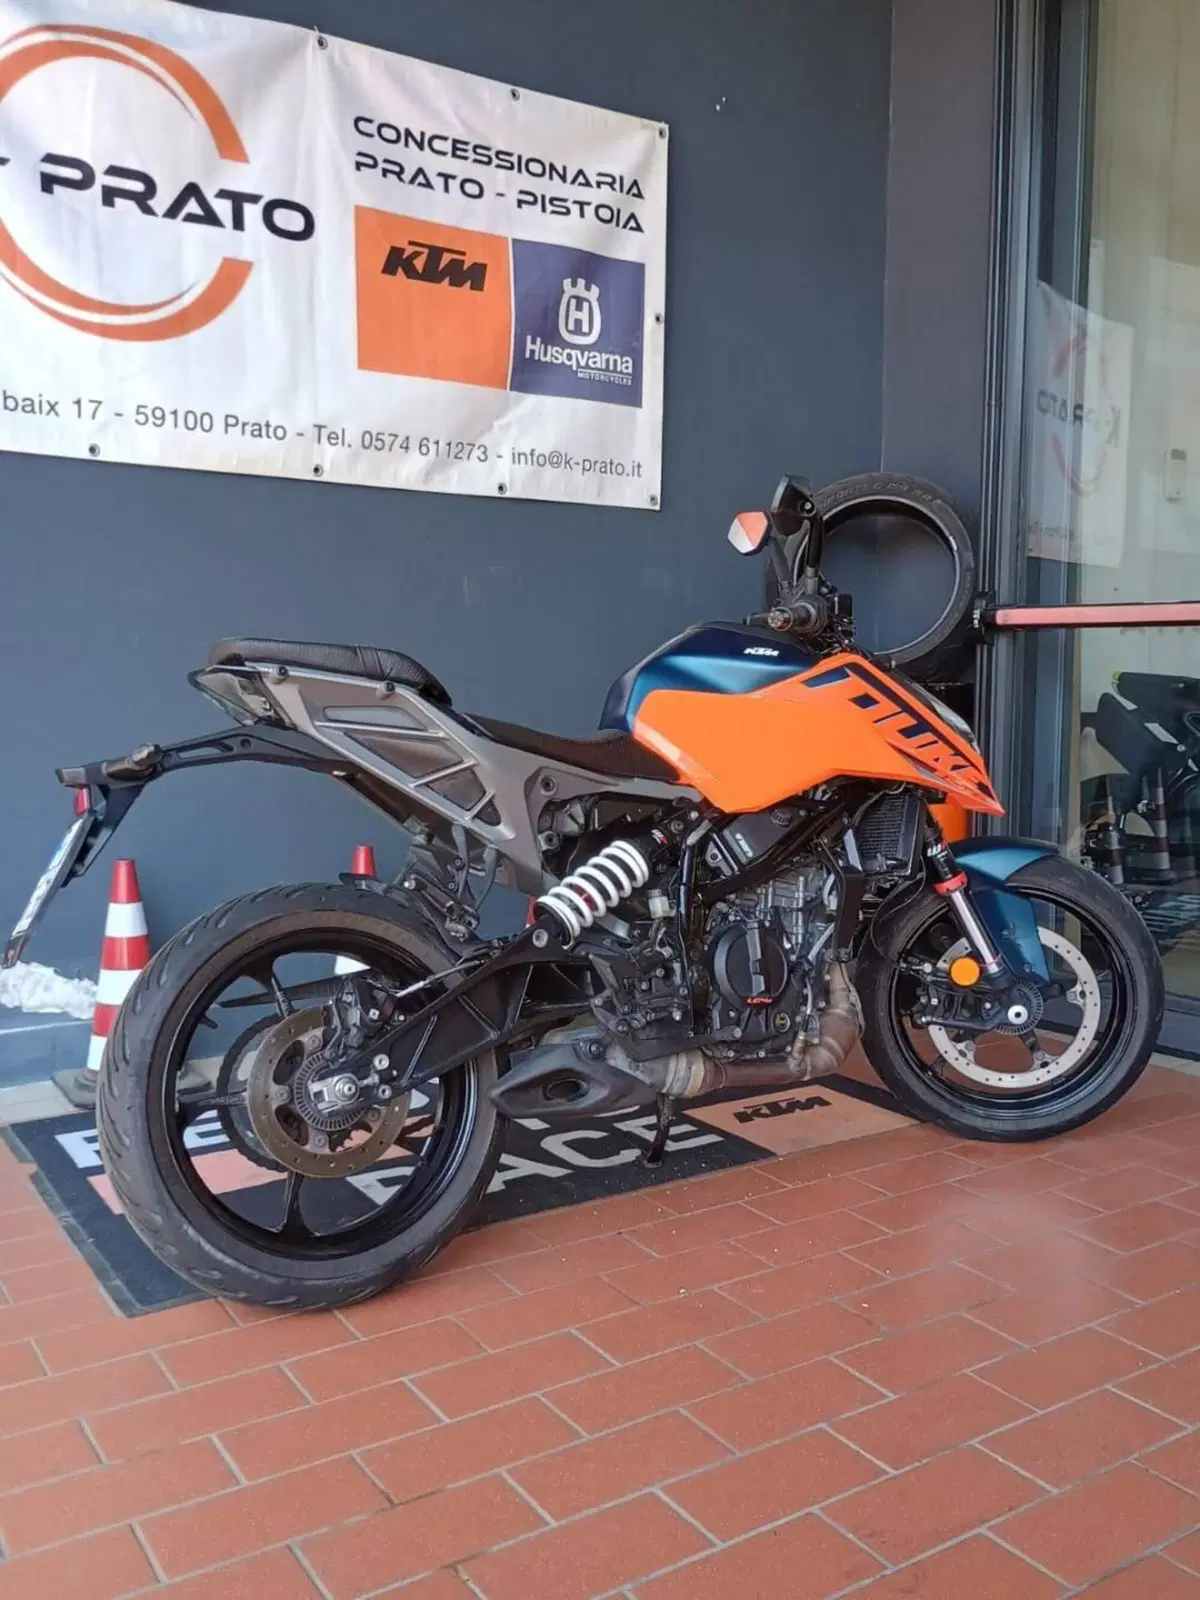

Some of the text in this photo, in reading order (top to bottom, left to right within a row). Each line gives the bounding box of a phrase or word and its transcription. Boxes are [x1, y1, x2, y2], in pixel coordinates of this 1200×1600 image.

[353, 116, 645, 199] CONCESSIONARIA
[40, 152, 315, 242] PRATO
[354, 151, 485, 199] PRATO
[516, 189, 644, 233] PISTOIA
[380, 240, 488, 292] KTM
[524, 334, 633, 375] Husqvarna
[73, 398, 103, 420] 17
[135, 405, 214, 433] 59100
[224, 415, 287, 441] Prato
[313, 424, 352, 448] Tel.
[361, 430, 410, 454] 0574
[418, 437, 488, 463] 611273
[511, 447, 642, 478] info@k-prato.it
[743, 646, 780, 658] KTM
[733, 1095, 832, 1123] KTM
